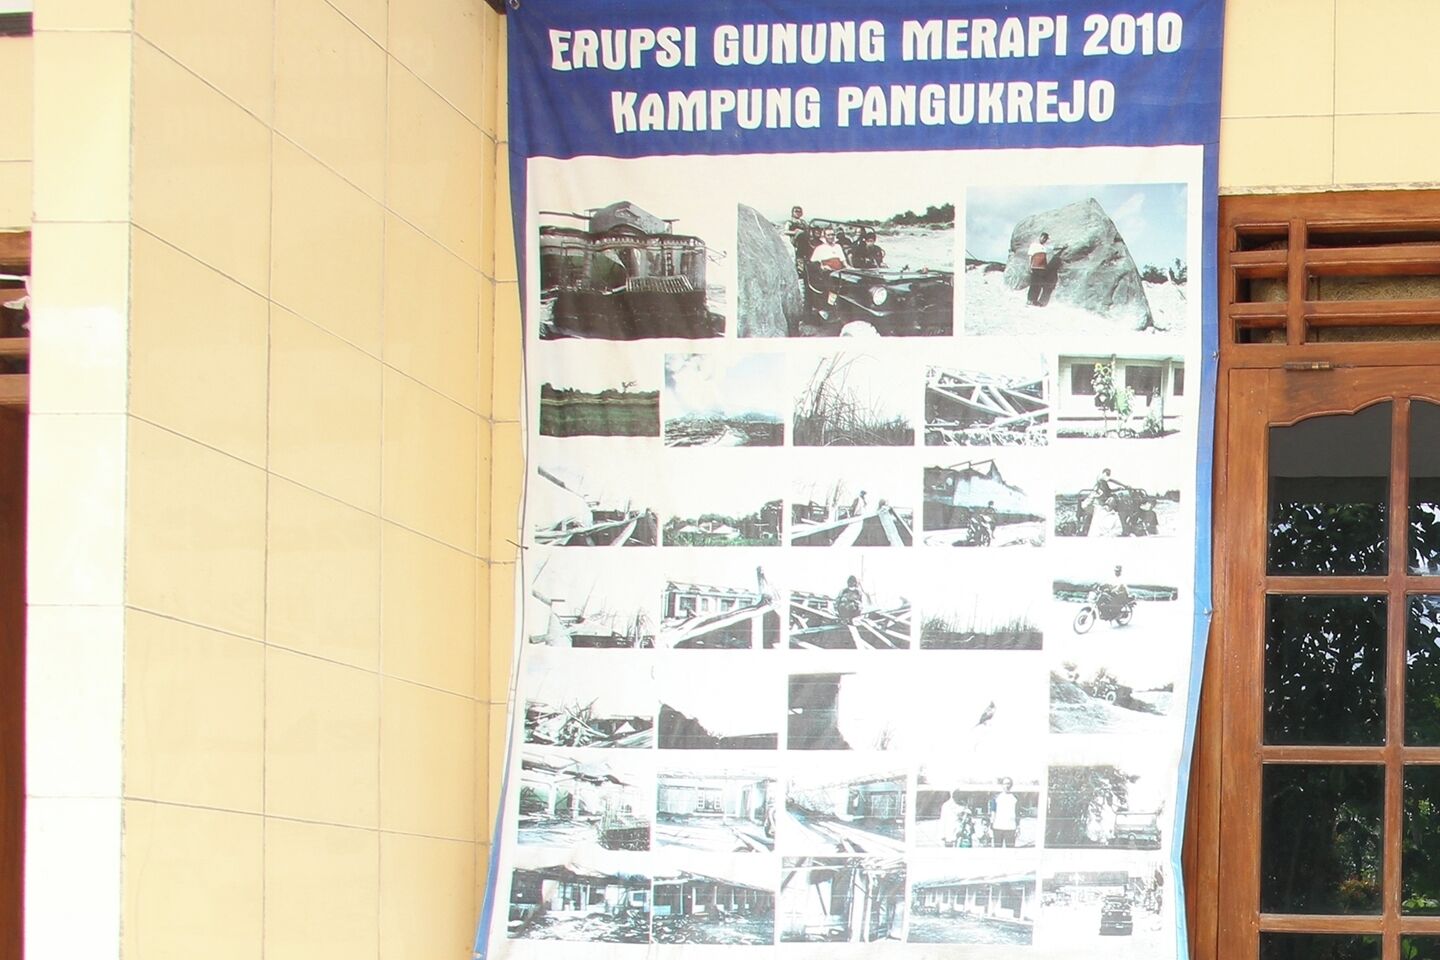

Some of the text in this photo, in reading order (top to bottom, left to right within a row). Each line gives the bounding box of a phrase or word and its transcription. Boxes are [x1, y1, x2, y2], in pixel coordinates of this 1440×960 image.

[549, 11, 1184, 71] ERUPSI GUNUNG MERAPI 2010
[611, 79, 1116, 134] KAMPUNG PANGUKREJO
